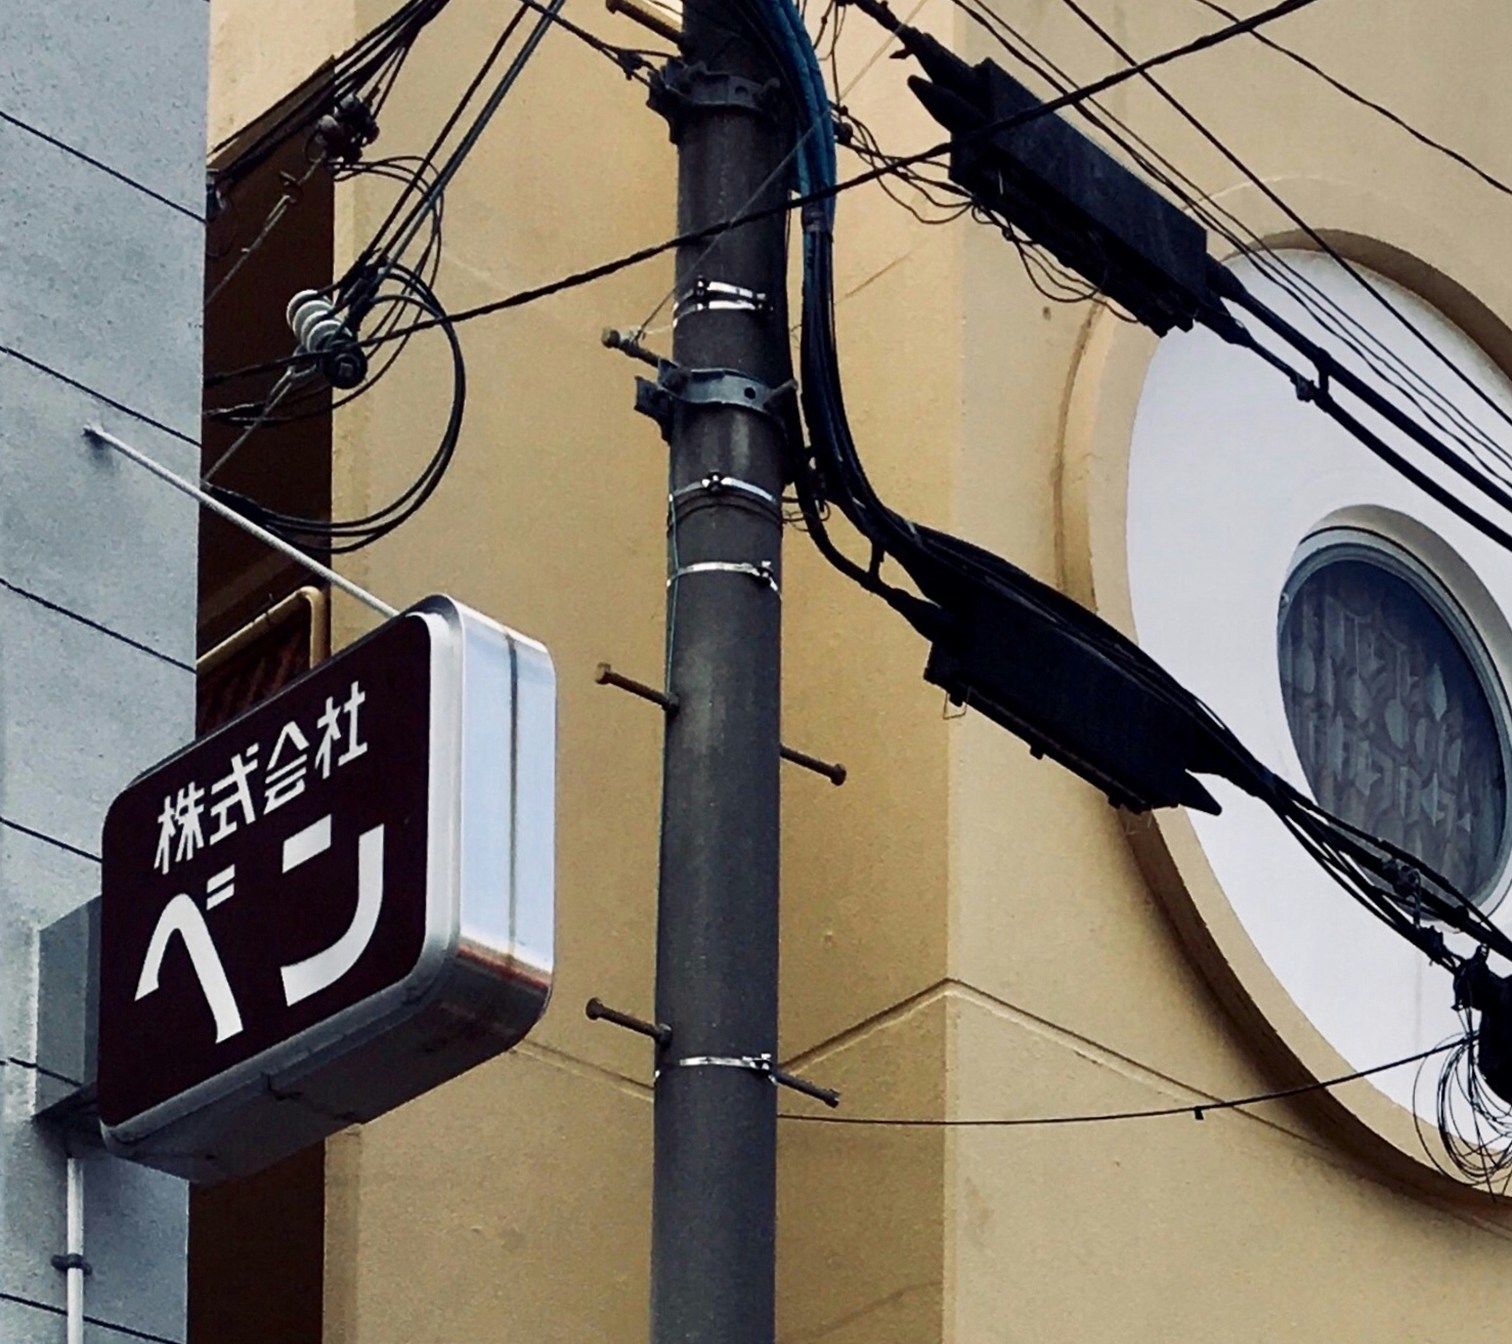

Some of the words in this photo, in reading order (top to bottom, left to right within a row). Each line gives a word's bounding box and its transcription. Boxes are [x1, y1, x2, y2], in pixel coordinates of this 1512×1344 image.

[154, 681, 368, 875] 株式会社
[135, 814, 384, 1043] ベン
